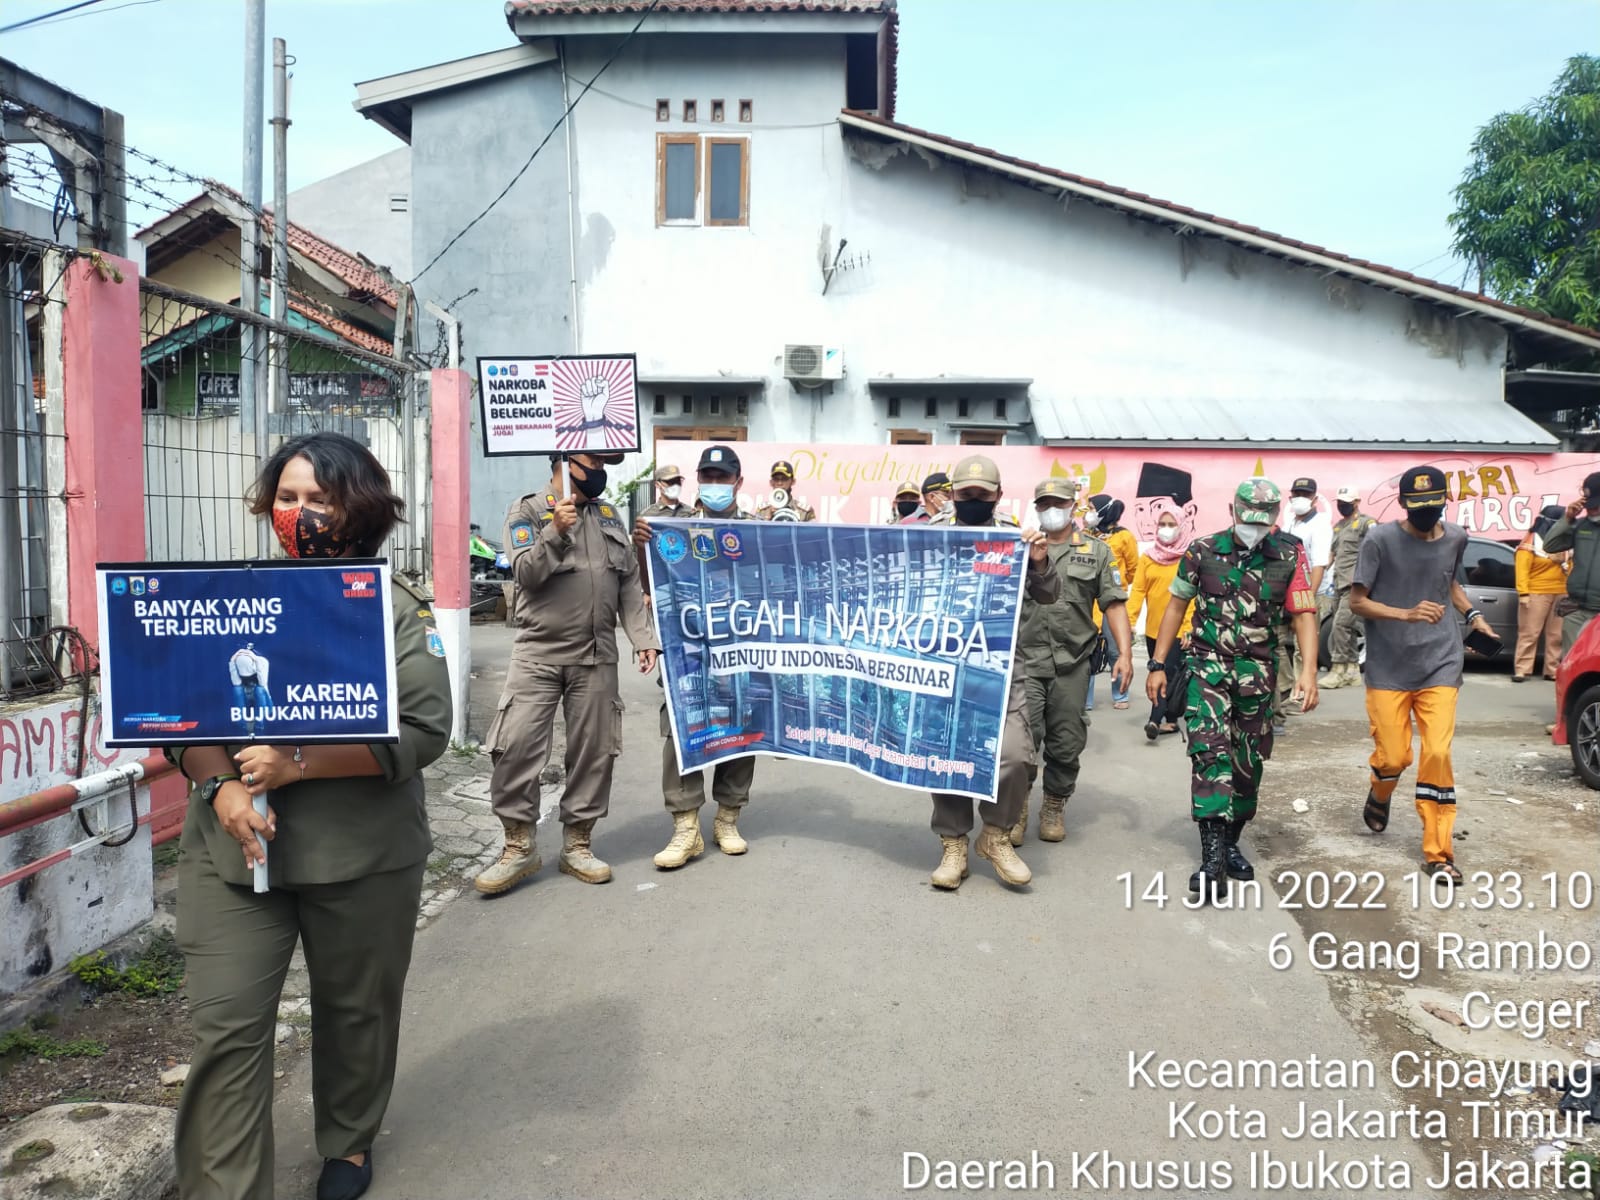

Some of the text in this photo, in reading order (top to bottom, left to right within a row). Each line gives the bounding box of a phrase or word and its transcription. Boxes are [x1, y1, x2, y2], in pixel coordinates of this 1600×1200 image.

[489, 379, 546, 391] NARKOBA
[489, 393, 537, 405] ADALAH
[490, 407, 552, 419] BELENGGU
[514, 423, 553, 431] SEKARANG
[134, 598, 283, 617] BANYAK YANG
[141, 616, 277, 636] TERJERUMUS
[680, 600, 992, 663] CEGAH NARKOBA
[711, 649, 950, 689] MENUJU INDONESIA BERSINAR
[287, 683, 379, 703] KARENA
[231, 704, 377, 722] BUJUKAN HALUS
[814, 727, 827, 742] PP
[927, 755, 975, 778] Cipayung
